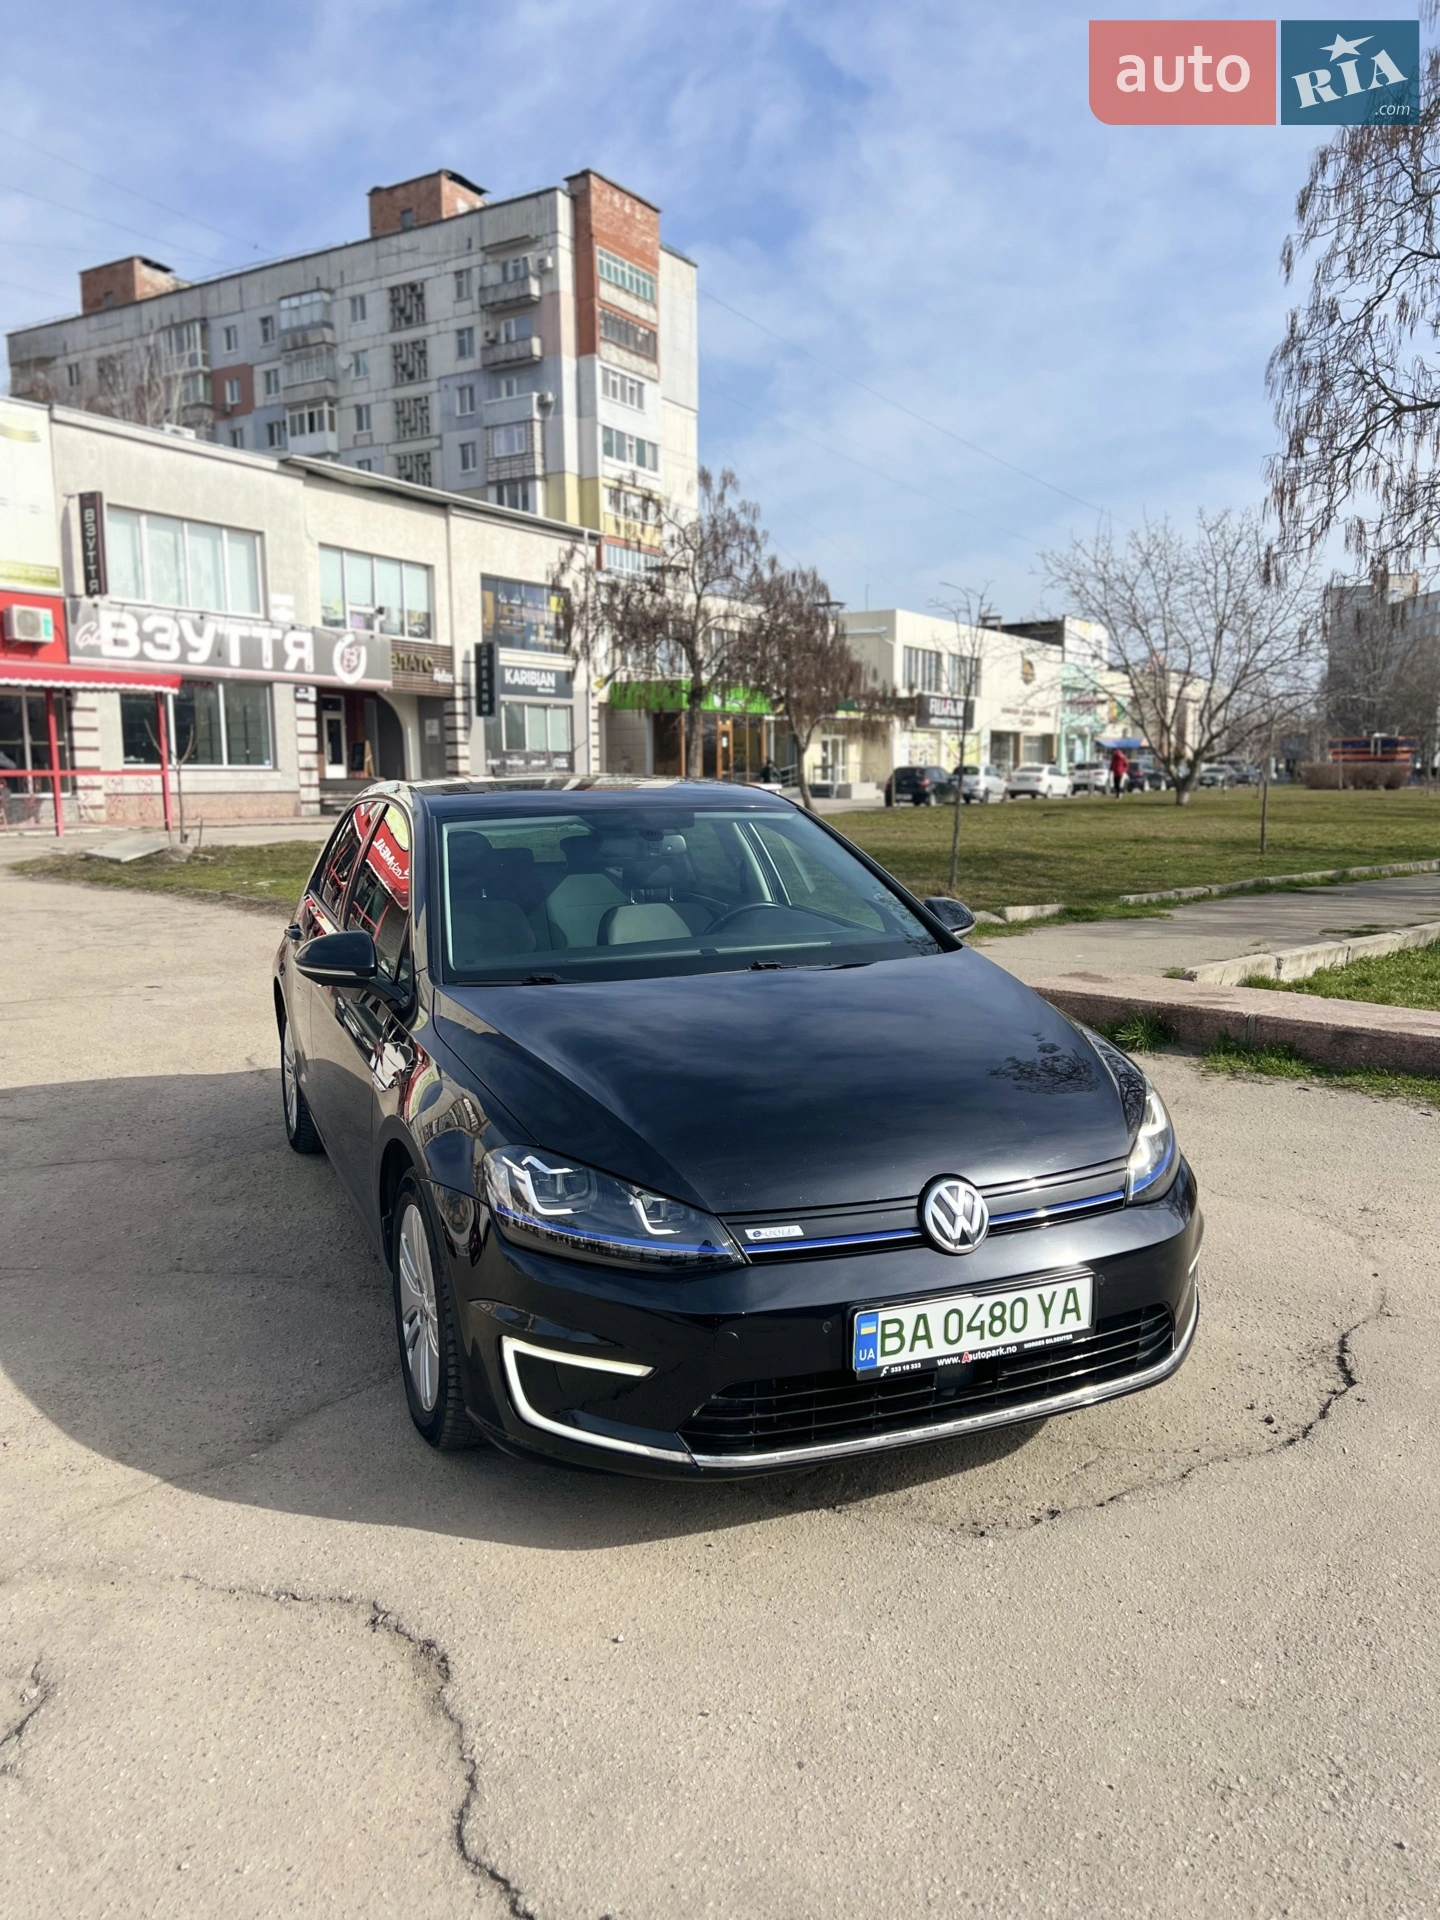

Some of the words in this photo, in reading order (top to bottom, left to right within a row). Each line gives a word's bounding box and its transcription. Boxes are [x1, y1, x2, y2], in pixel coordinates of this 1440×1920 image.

[84, 508, 101, 592] ВЗУТТЯ
[99, 609, 315, 672] ВЗУТТЯ
[504, 667, 556, 688] KARIBIAN
[880, 1313, 934, 1357] BA
[943, 1297, 1028, 1345] 0480
[1038, 1287, 1082, 1329] YA
[858, 1347, 876, 1361] UA
